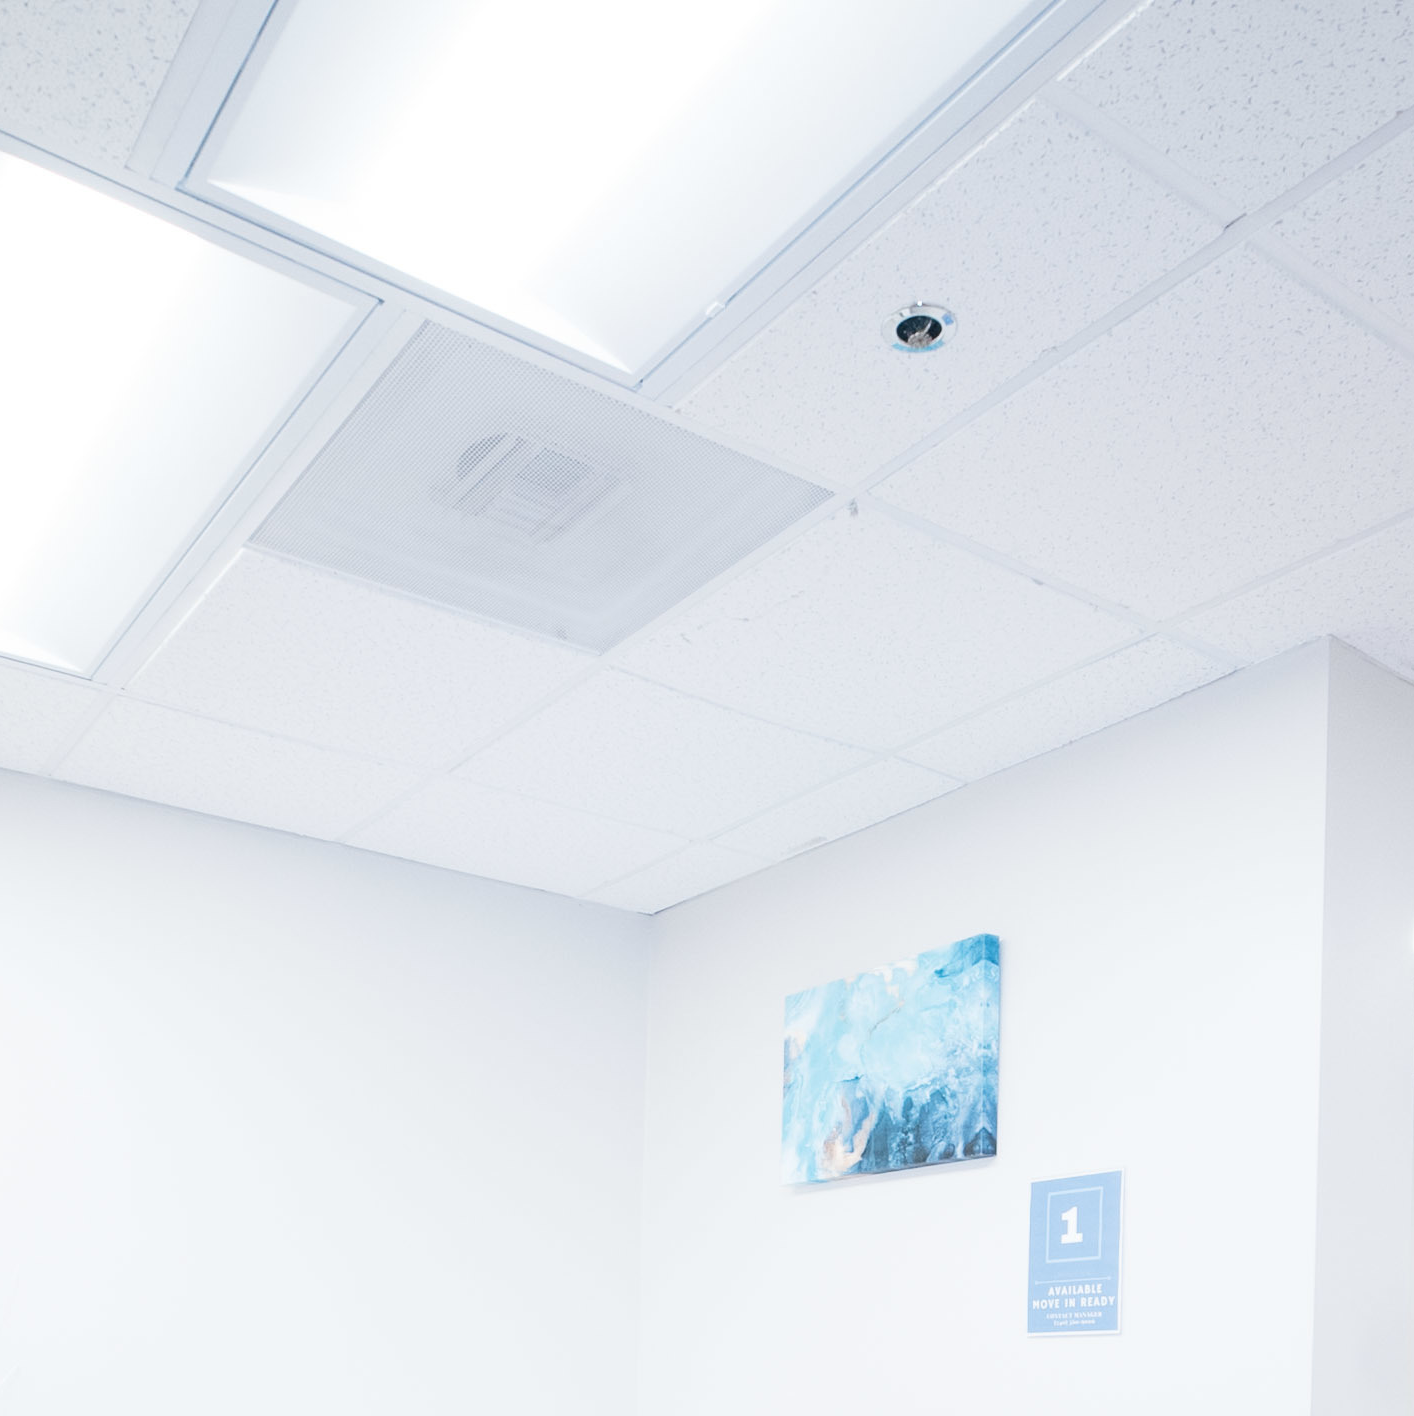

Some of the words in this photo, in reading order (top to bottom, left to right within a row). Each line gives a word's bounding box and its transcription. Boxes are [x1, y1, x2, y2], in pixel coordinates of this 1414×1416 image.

[1060, 1206, 1083, 1244] 1
[1048, 1283, 1102, 1296] AVAILABLE
[1032, 1298, 1060, 1309] MOVE
[1064, 1297, 1076, 1308] IN
[1081, 1296, 1115, 1307] READY
